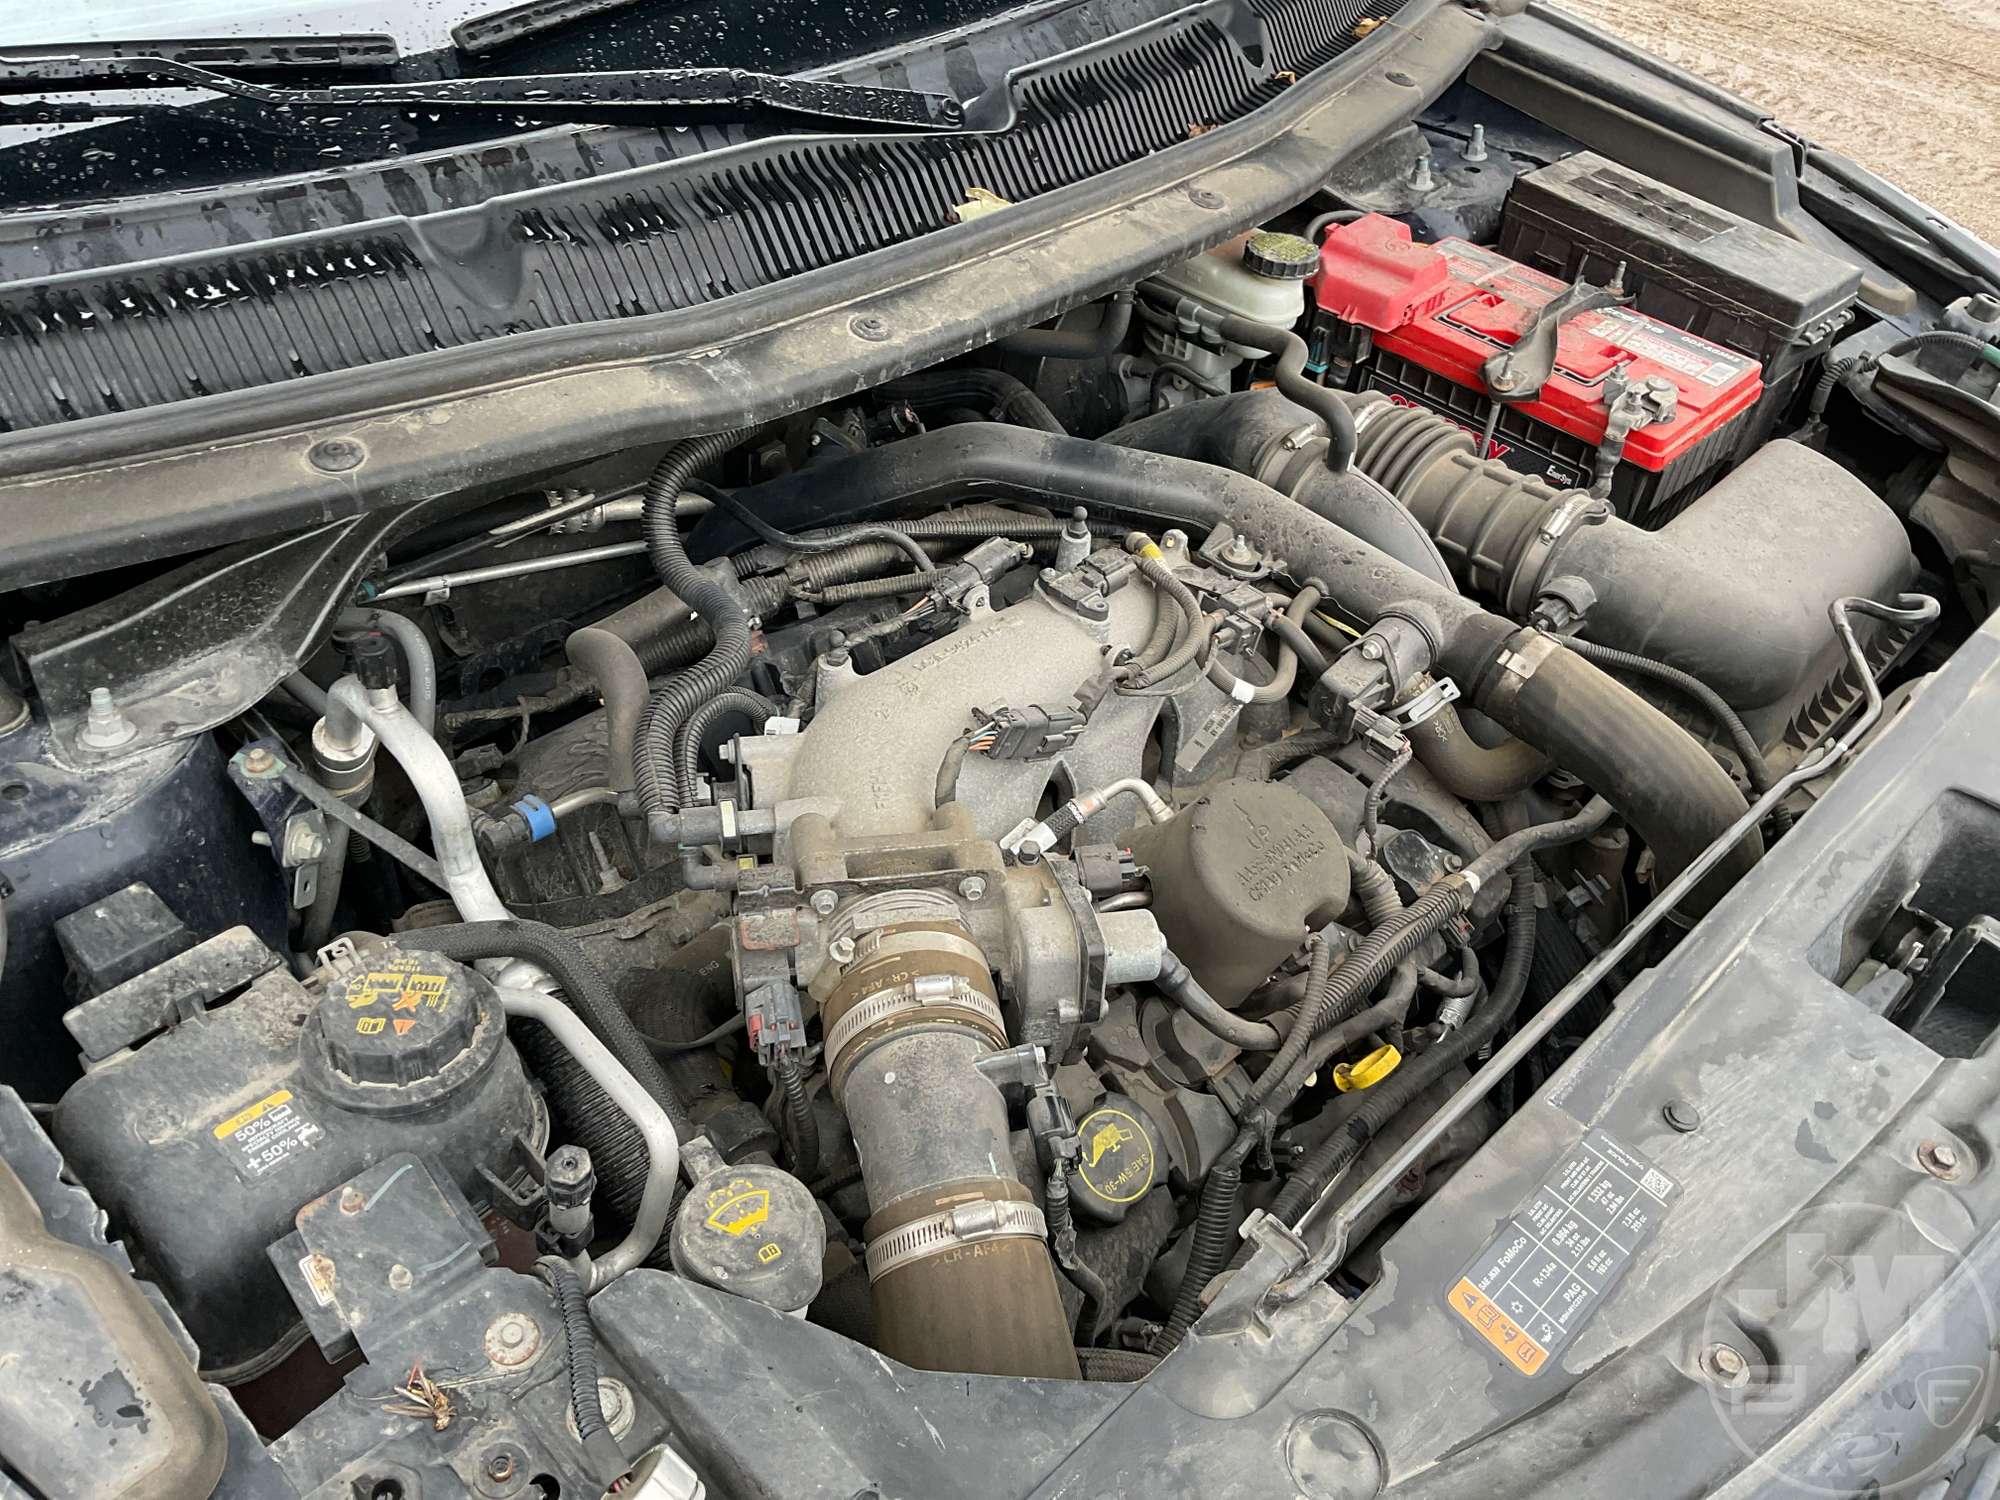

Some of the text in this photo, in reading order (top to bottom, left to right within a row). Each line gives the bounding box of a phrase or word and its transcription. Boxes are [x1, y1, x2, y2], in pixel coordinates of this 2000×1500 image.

[233, 1114, 272, 1143] 50%
[1104, 1153, 1150, 1194] SAE 5W-30
[1477, 1276, 1491, 1291] SAE
[1496, 1233, 1527, 1269] FoMoCo
[1532, 1260, 1557, 1288] R-134a
[1562, 1282, 1582, 1303] PAG
